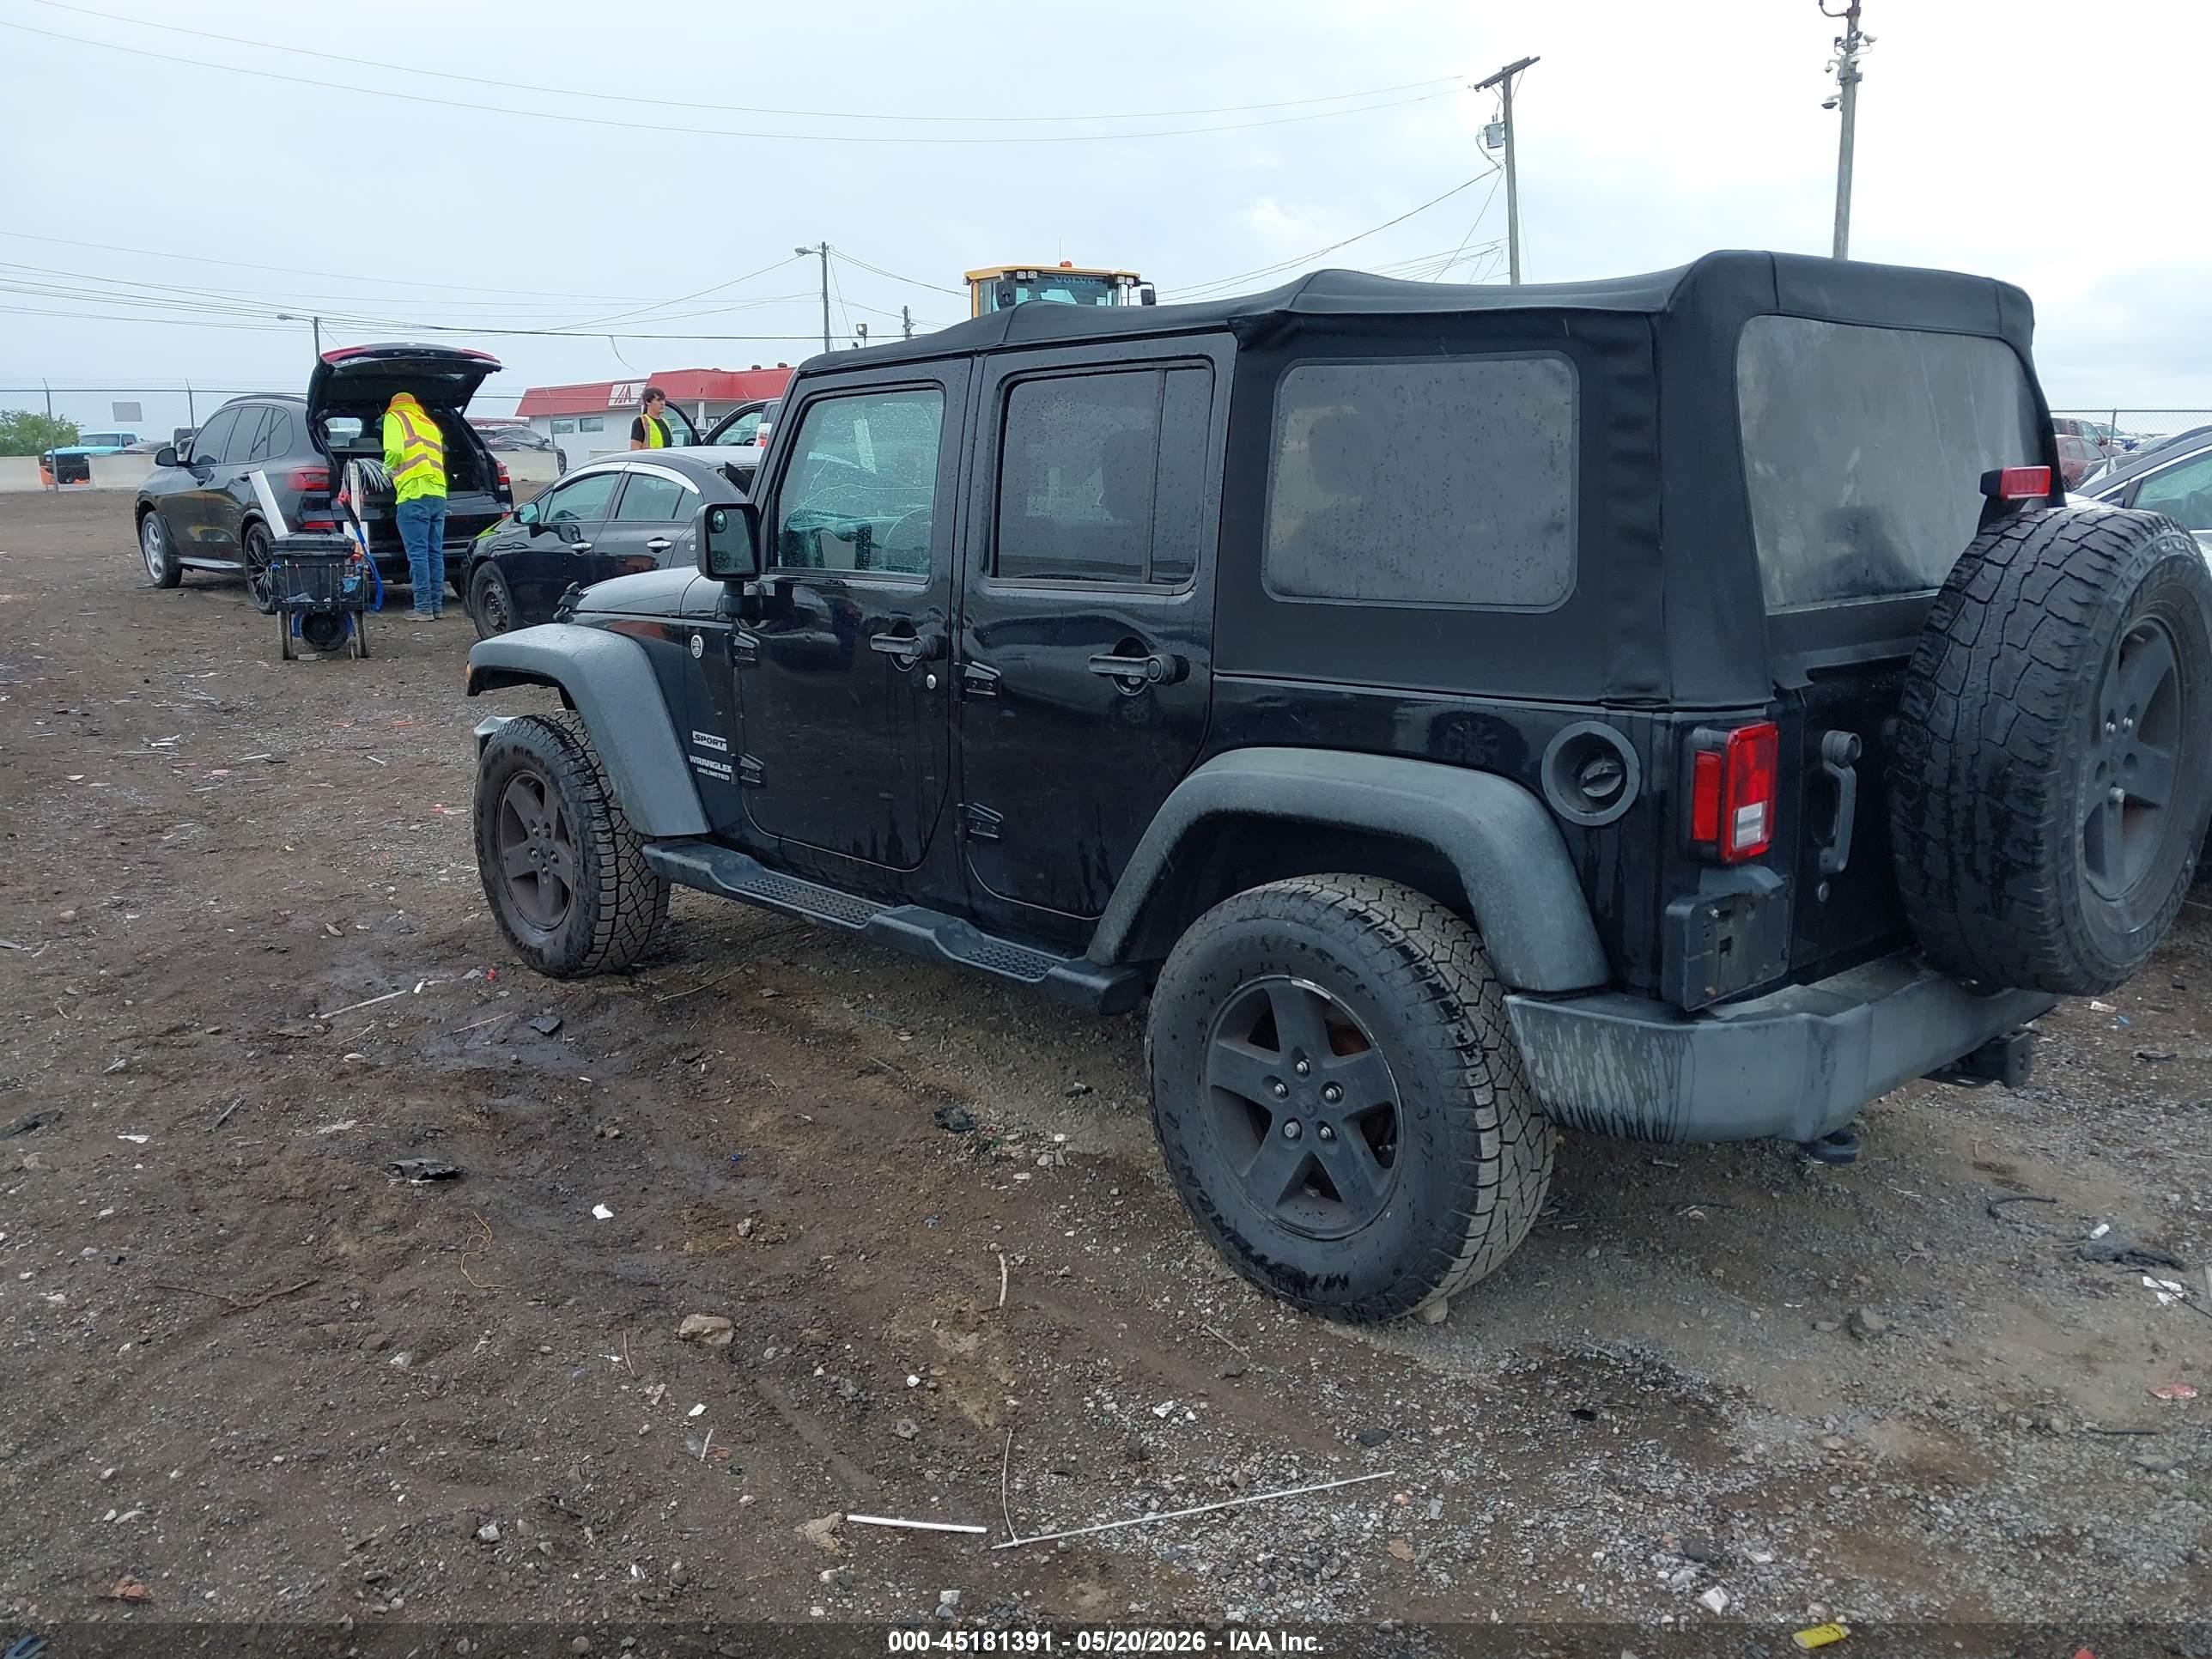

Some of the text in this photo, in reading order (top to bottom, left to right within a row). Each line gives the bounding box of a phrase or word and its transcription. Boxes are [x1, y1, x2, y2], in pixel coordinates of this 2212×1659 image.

[693, 732, 727, 748] SPORT
[689, 755, 732, 773] WRANGLER
[696, 767, 730, 781] UNLIMITED
